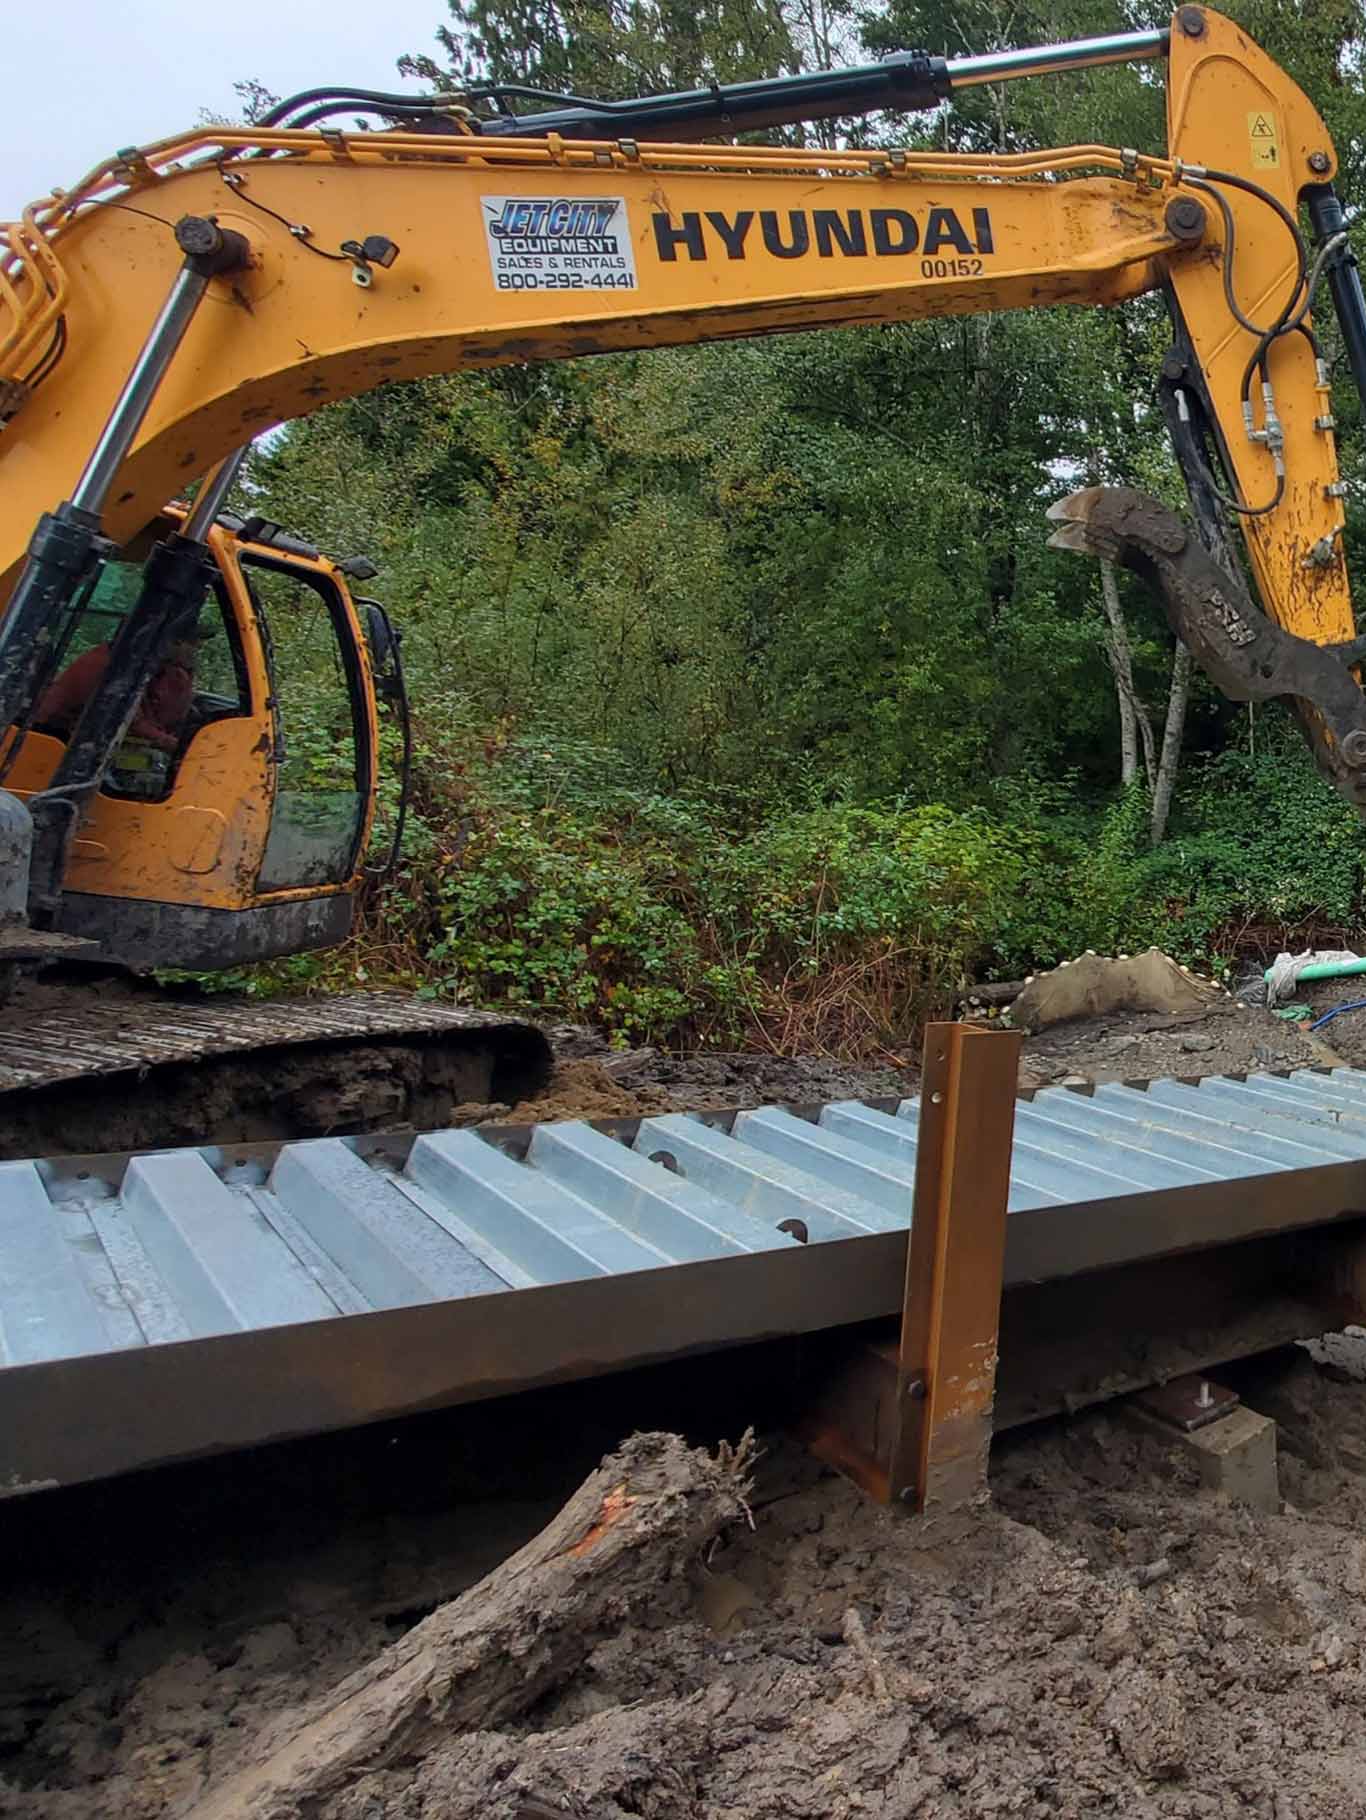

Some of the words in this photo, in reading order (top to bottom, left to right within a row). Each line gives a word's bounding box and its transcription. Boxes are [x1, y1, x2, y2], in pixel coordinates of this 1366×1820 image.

[489, 200, 552, 238] JET
[547, 199, 620, 238] CITY
[651, 207, 995, 262] HYUNDAI
[501, 237, 616, 253] EQUIPMENT
[497, 256, 543, 269] SALES
[548, 256, 559, 269] &
[564, 256, 626, 269] RENTALS
[920, 259, 984, 279] 00152
[497, 272, 635, 289] 800-292-4441
